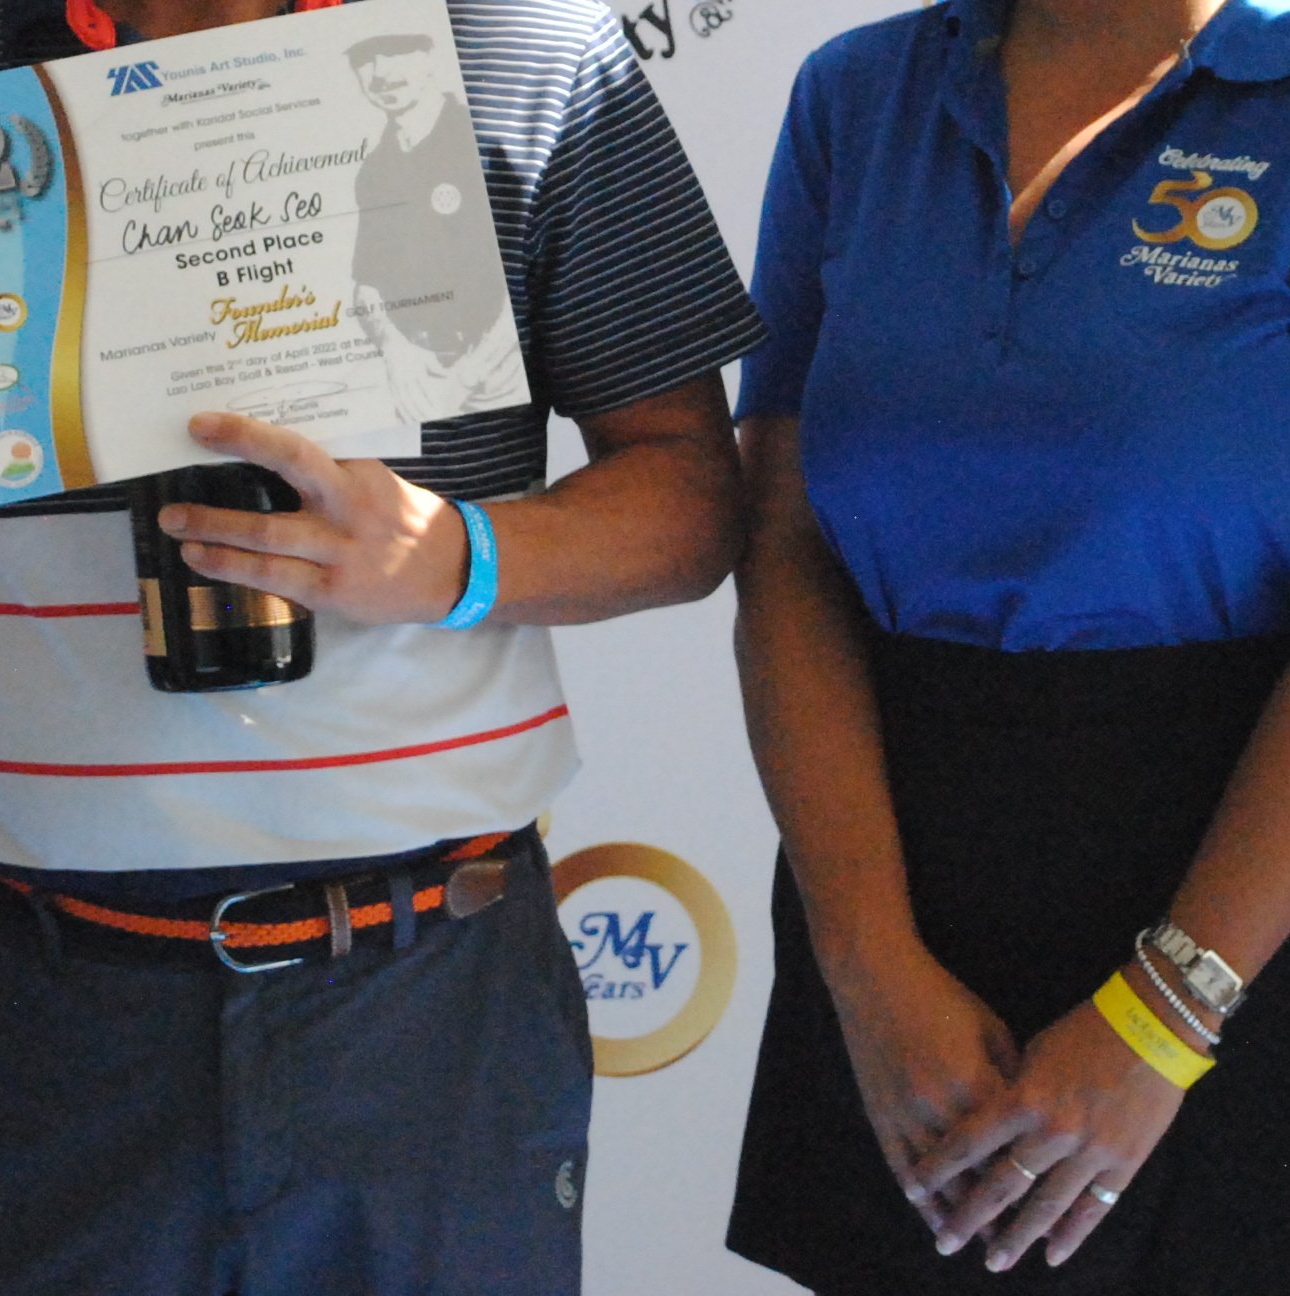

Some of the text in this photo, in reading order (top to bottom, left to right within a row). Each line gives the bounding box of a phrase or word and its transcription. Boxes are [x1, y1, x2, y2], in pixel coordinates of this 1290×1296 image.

[162, 65, 207, 81] Younis
[210, 60, 230, 73] Art
[233, 51, 280, 68] Studio,
[161, 87, 215, 107] Marianas
[217, 78, 258, 93] Variety
[121, 124, 168, 142] together
[171, 120, 193, 132] with
[238, 106, 273, 120] Social
[274, 97, 321, 112] Services
[193, 130, 255, 152] present this
[99, 137, 369, 213] Certificate of Achievement
[1159, 145, 1270, 181] Celebrating
[122, 219, 199, 254] Chan
[279, 190, 323, 223] Seo
[1131, 171, 1258, 250] 50
[175, 230, 324, 269] Second Place
[1120, 246, 1239, 272] Marianas
[216, 258, 294, 287] B Flight
[1144, 266, 1237, 288] Variety
[210, 284, 316, 325] Founder's
[100, 290, 454, 362] Marianas Variety Memorial GOLF TOURNAMENT
[167, 385, 188, 397] Lao
[190, 380, 212, 392] Lao
[214, 373, 237, 388] Bay
[238, 368, 262, 383] Golf
[276, 361, 309, 375] Resort
[317, 356, 344, 368] West
[346, 348, 384, 363] Course
[171, 367, 204, 381] Given
[206, 361, 225, 374] this
[245, 355, 267, 368] day
[271, 351, 283, 362] of
[284, 347, 309, 363] April
[311, 342, 337, 354] 2022
[340, 339, 352, 350] at
[583, 973, 646, 1000] ears
